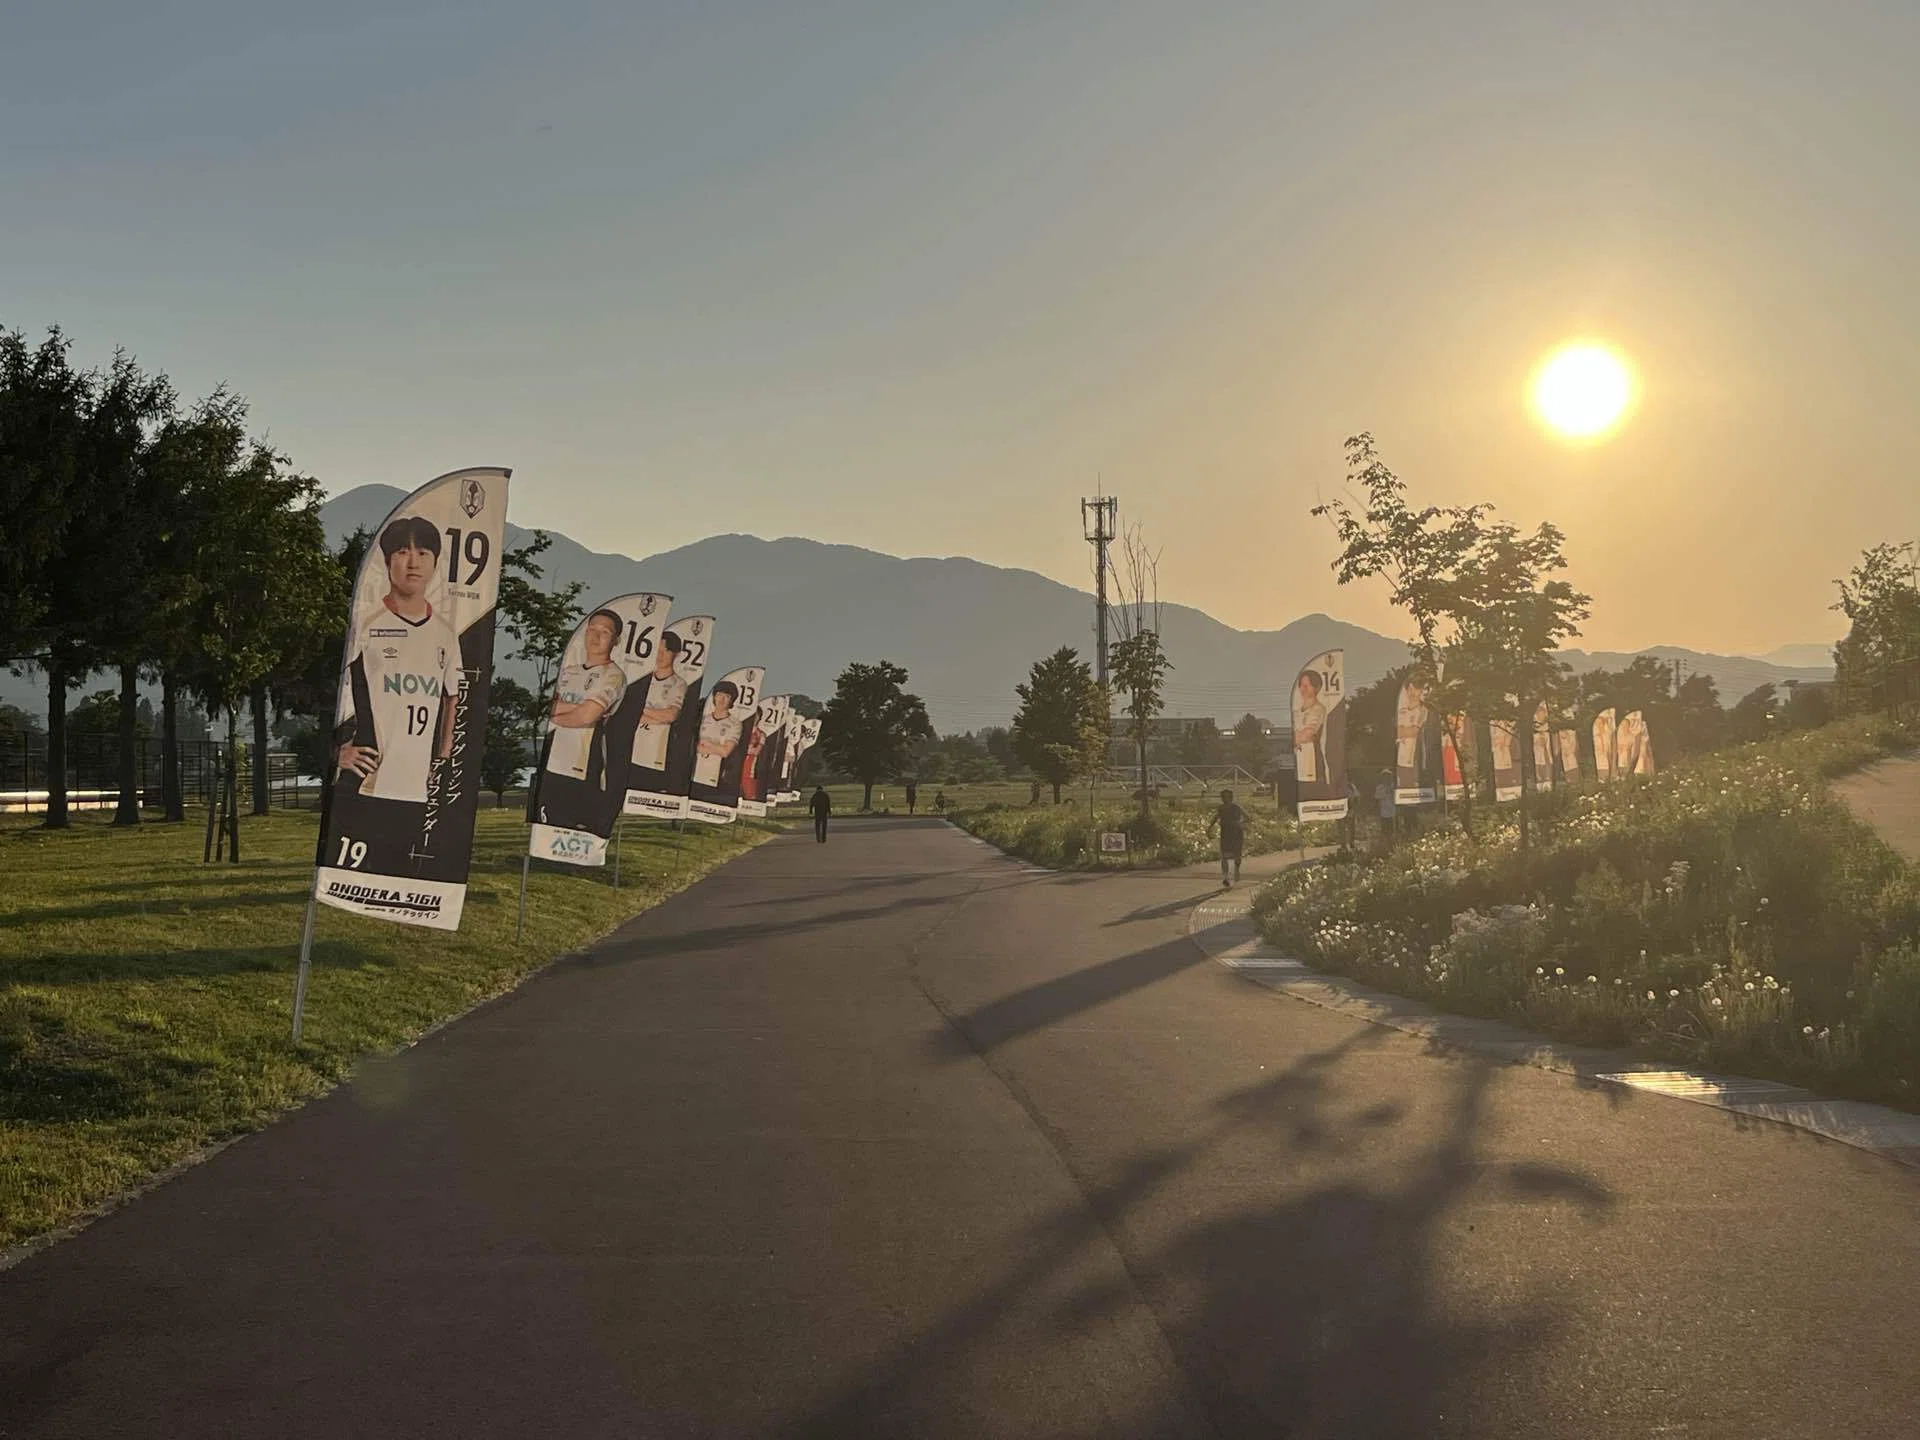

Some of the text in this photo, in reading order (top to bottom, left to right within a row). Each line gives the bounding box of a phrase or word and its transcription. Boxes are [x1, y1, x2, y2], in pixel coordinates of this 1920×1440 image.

[445, 527, 489, 585] 19
[624, 620, 655, 658] 16
[680, 640, 705, 666] 52
[384, 672, 441, 698] NOVA
[1322, 671, 1340, 692] 14
[739, 685, 755, 706] 13
[407, 705, 428, 735] 19
[764, 707, 778, 724] 21
[804, 728, 817, 740] 84
[336, 835, 368, 868] 19
[551, 836, 593, 855] ACT
[328, 882, 441, 906] ONODERA SIGN
